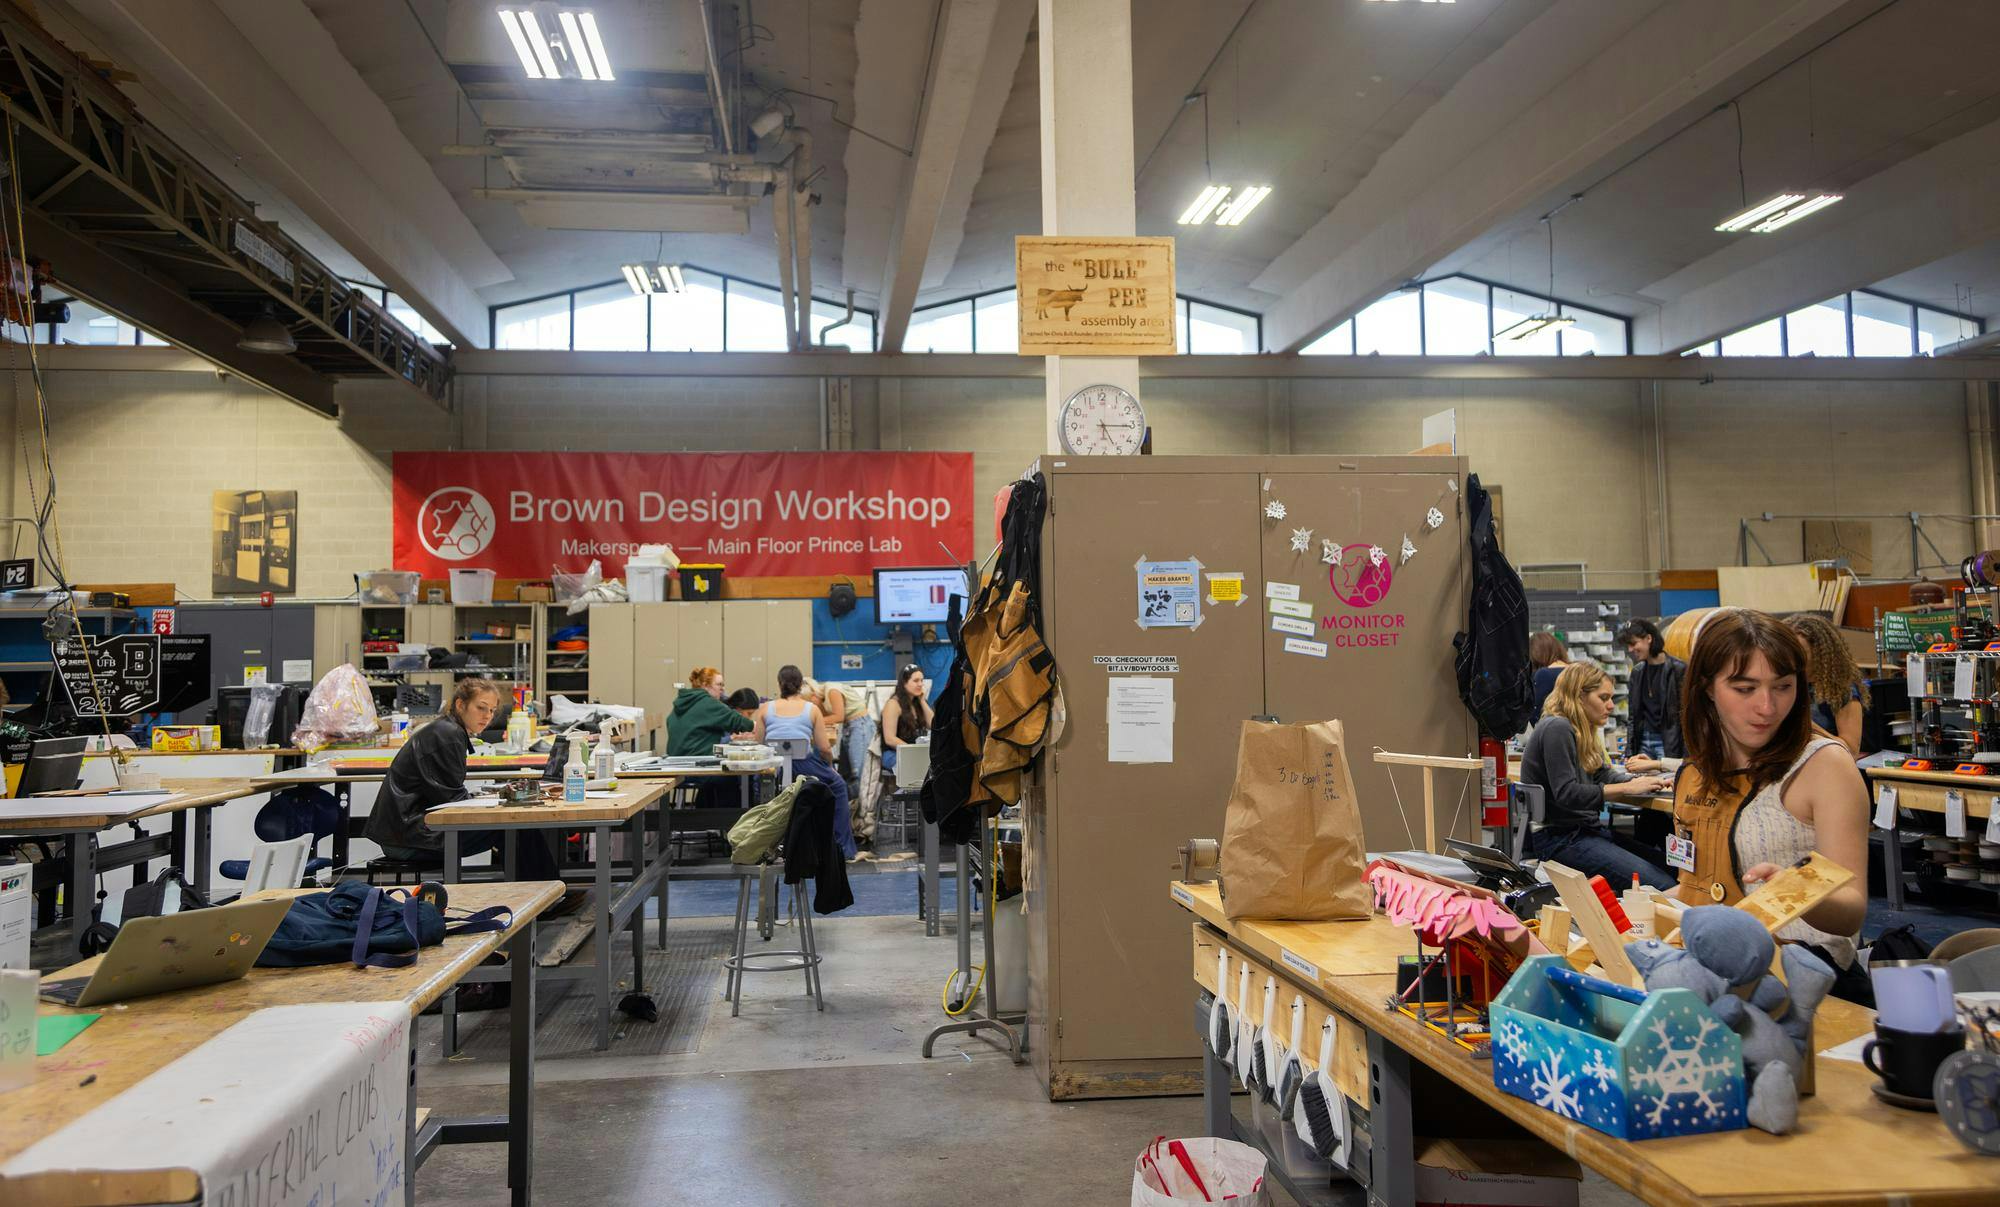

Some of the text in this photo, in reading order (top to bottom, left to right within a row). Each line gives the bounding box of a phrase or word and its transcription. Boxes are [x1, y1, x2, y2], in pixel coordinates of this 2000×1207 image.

[1045, 261, 1065, 272] the
[1108, 287, 1147, 308] PEN
[1081, 315, 1137, 328] assembly
[1084, 396, 1091, 405] 11
[1098, 392, 1106, 401] 12
[1073, 408, 1081, 416] 10
[1124, 406, 1131, 415] 2
[1071, 422, 1078, 431] 9
[1130, 420, 1136, 429] 3
[1075, 437, 1083, 446] 8
[1126, 434, 1132, 444] 4
[1116, 446, 1122, 455] 5
[510, 489, 950, 529] Brown Design Workshop
[708, 537, 750, 554] Main
[757, 537, 803, 554] Floor
[808, 536, 864, 553] Prince
[869, 535, 902, 552] Lab
[1322, 614, 1405, 630] MONITOR
[1336, 633, 1400, 648] CLOSET
[97, 659, 116, 667] UFB
[79, 697, 113, 715] 24
[336, 1063, 379, 1156] CLUB
